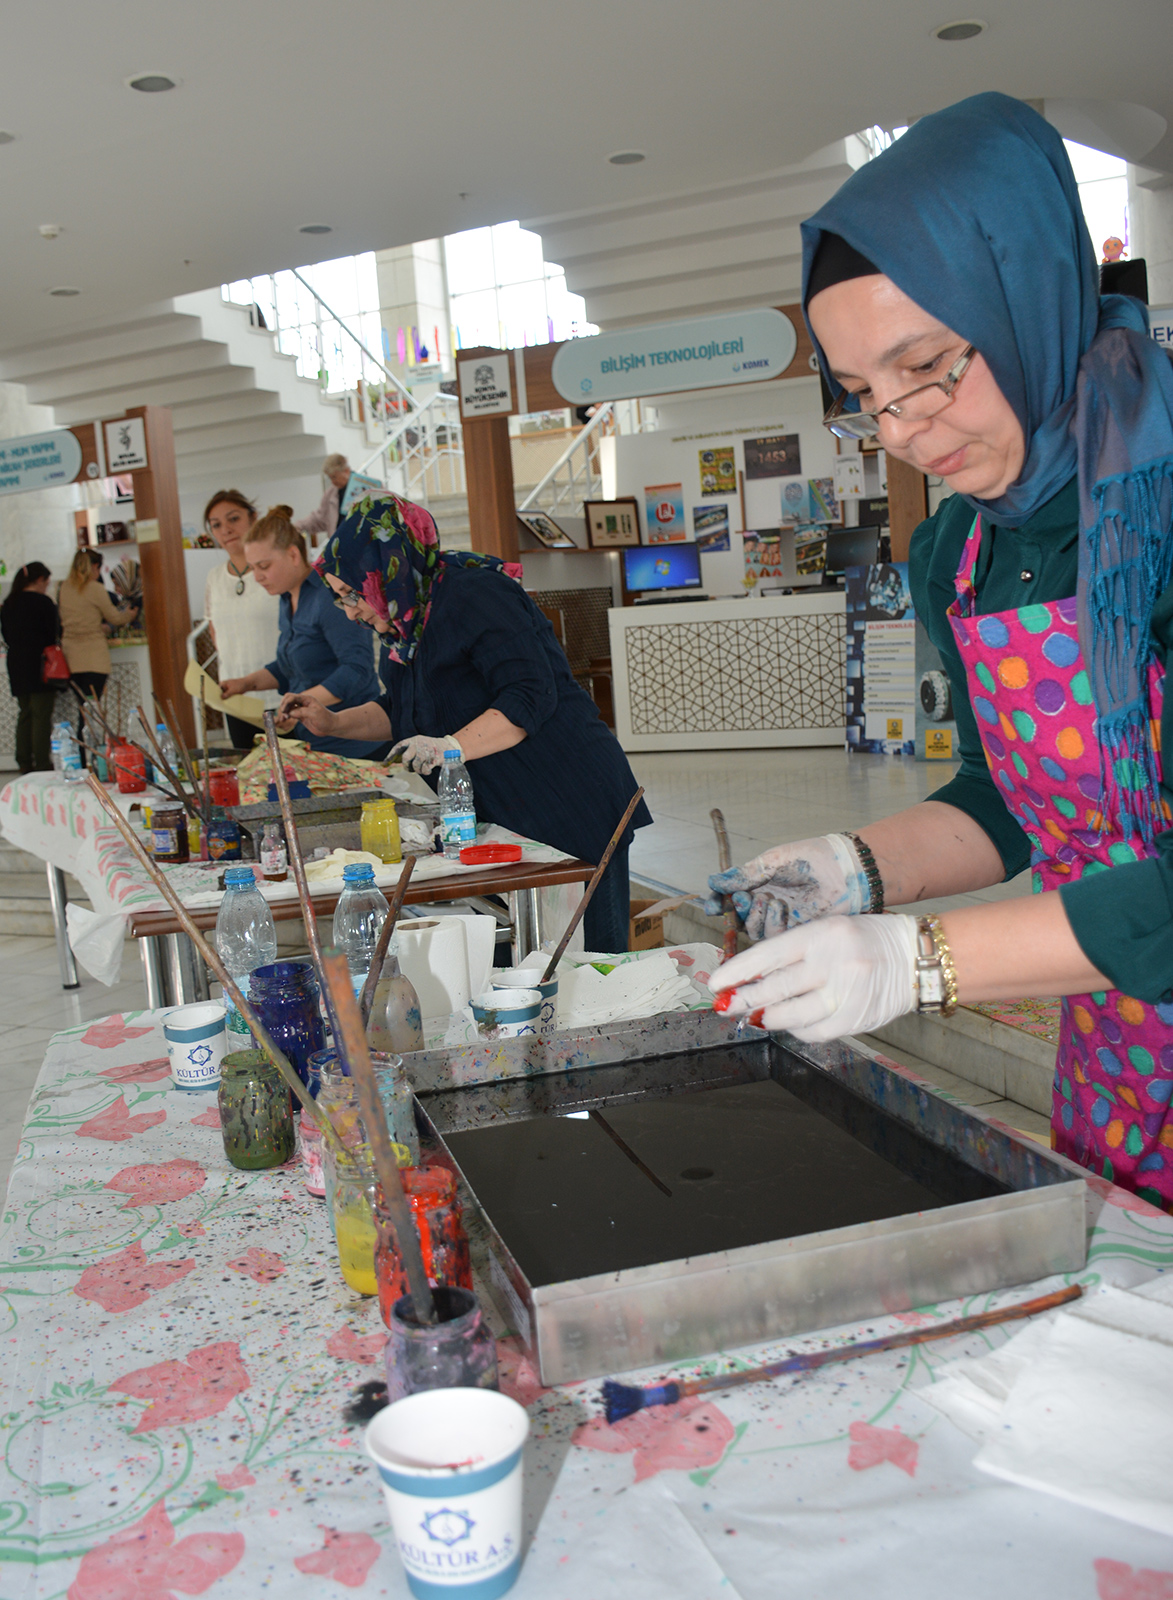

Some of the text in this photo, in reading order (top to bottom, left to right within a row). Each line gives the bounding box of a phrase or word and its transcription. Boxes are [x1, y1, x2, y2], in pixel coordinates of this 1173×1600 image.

[601, 337, 744, 374] BİLİŞİM TEKNOLOJİLERİ
[742, 358, 770, 371] KOMEK
[757, 450, 787, 464] 1453
[176, 1066, 216, 1079] KÜLTÜR
[399, 1540, 479, 1568] KÜLTÜR
